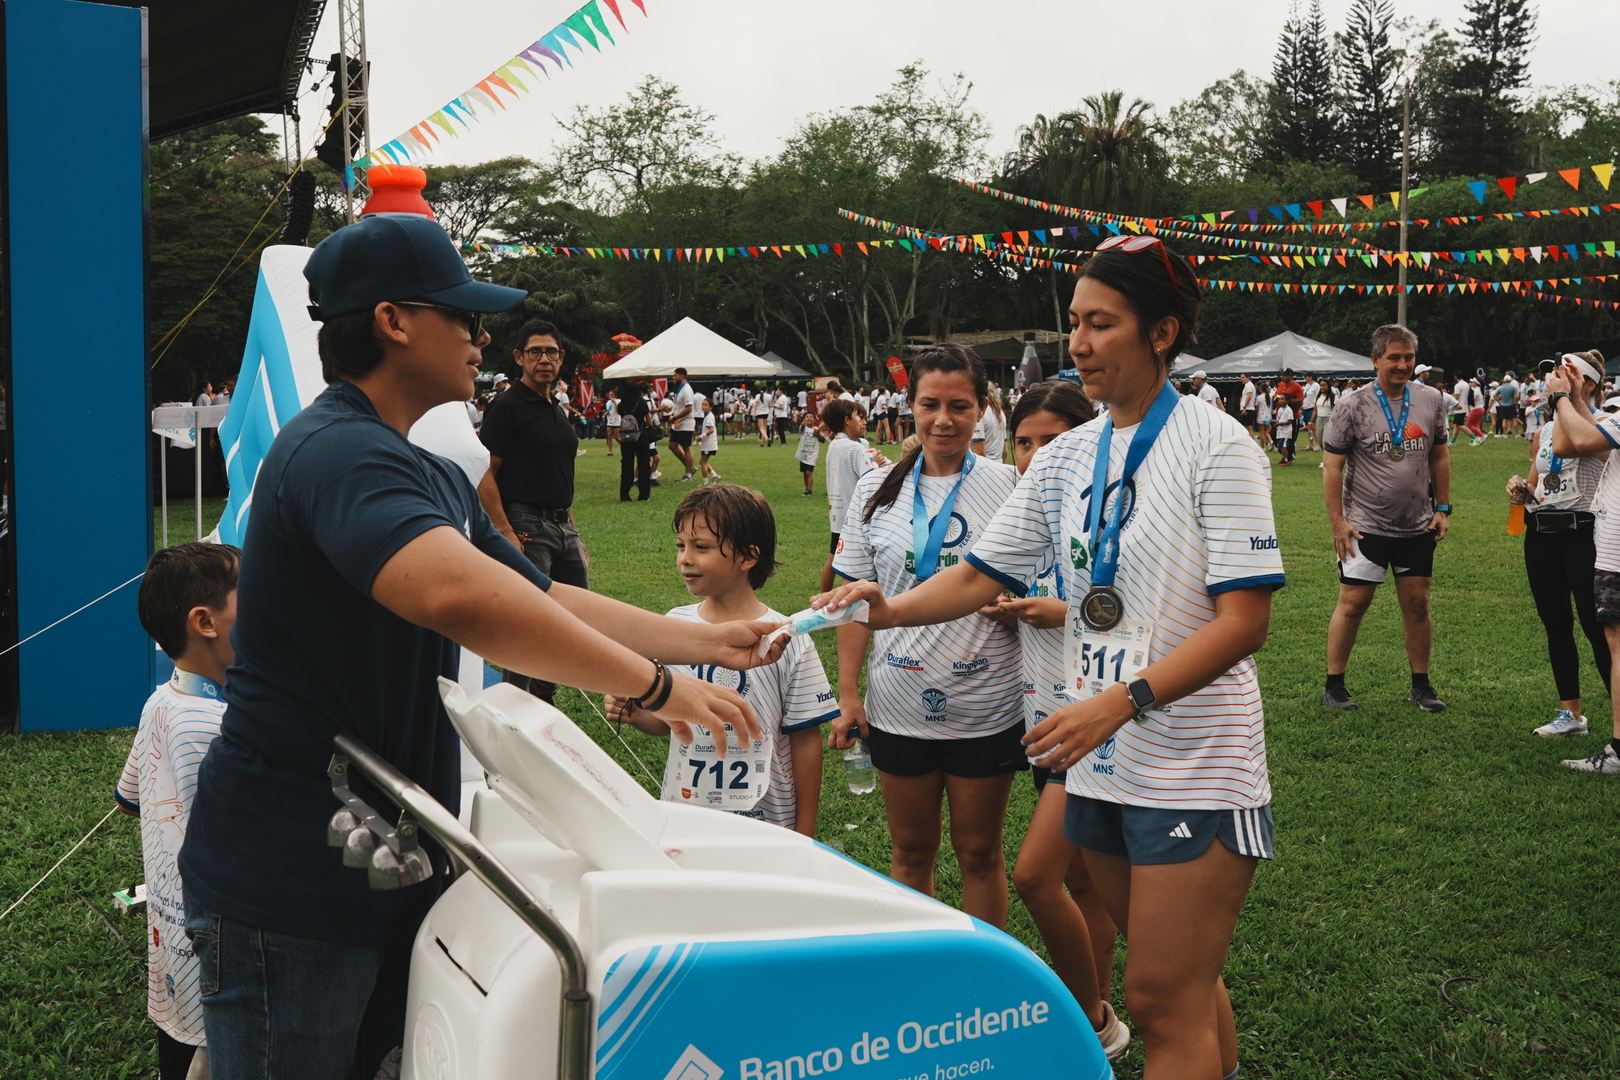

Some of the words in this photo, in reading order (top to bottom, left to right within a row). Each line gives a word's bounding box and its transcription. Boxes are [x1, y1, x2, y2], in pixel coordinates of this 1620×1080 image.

[1374, 437, 1425, 454] CAERA
[1375, 432, 1391, 443] LA
[1121, 506, 1139, 533] YEARS
[959, 529, 973, 549] YEARS
[1071, 547, 1084, 561] 5K
[887, 653, 921, 667] Duraflex
[952, 657, 988, 670] Kingspan
[1081, 642, 1126, 682] 511
[688, 759, 749, 789] 712
[740, 1047, 843, 1080] Banco
[850, 1031, 890, 1065] de
[897, 1000, 1049, 1055] Occidente
[935, 1058, 994, 1080] hacen.
